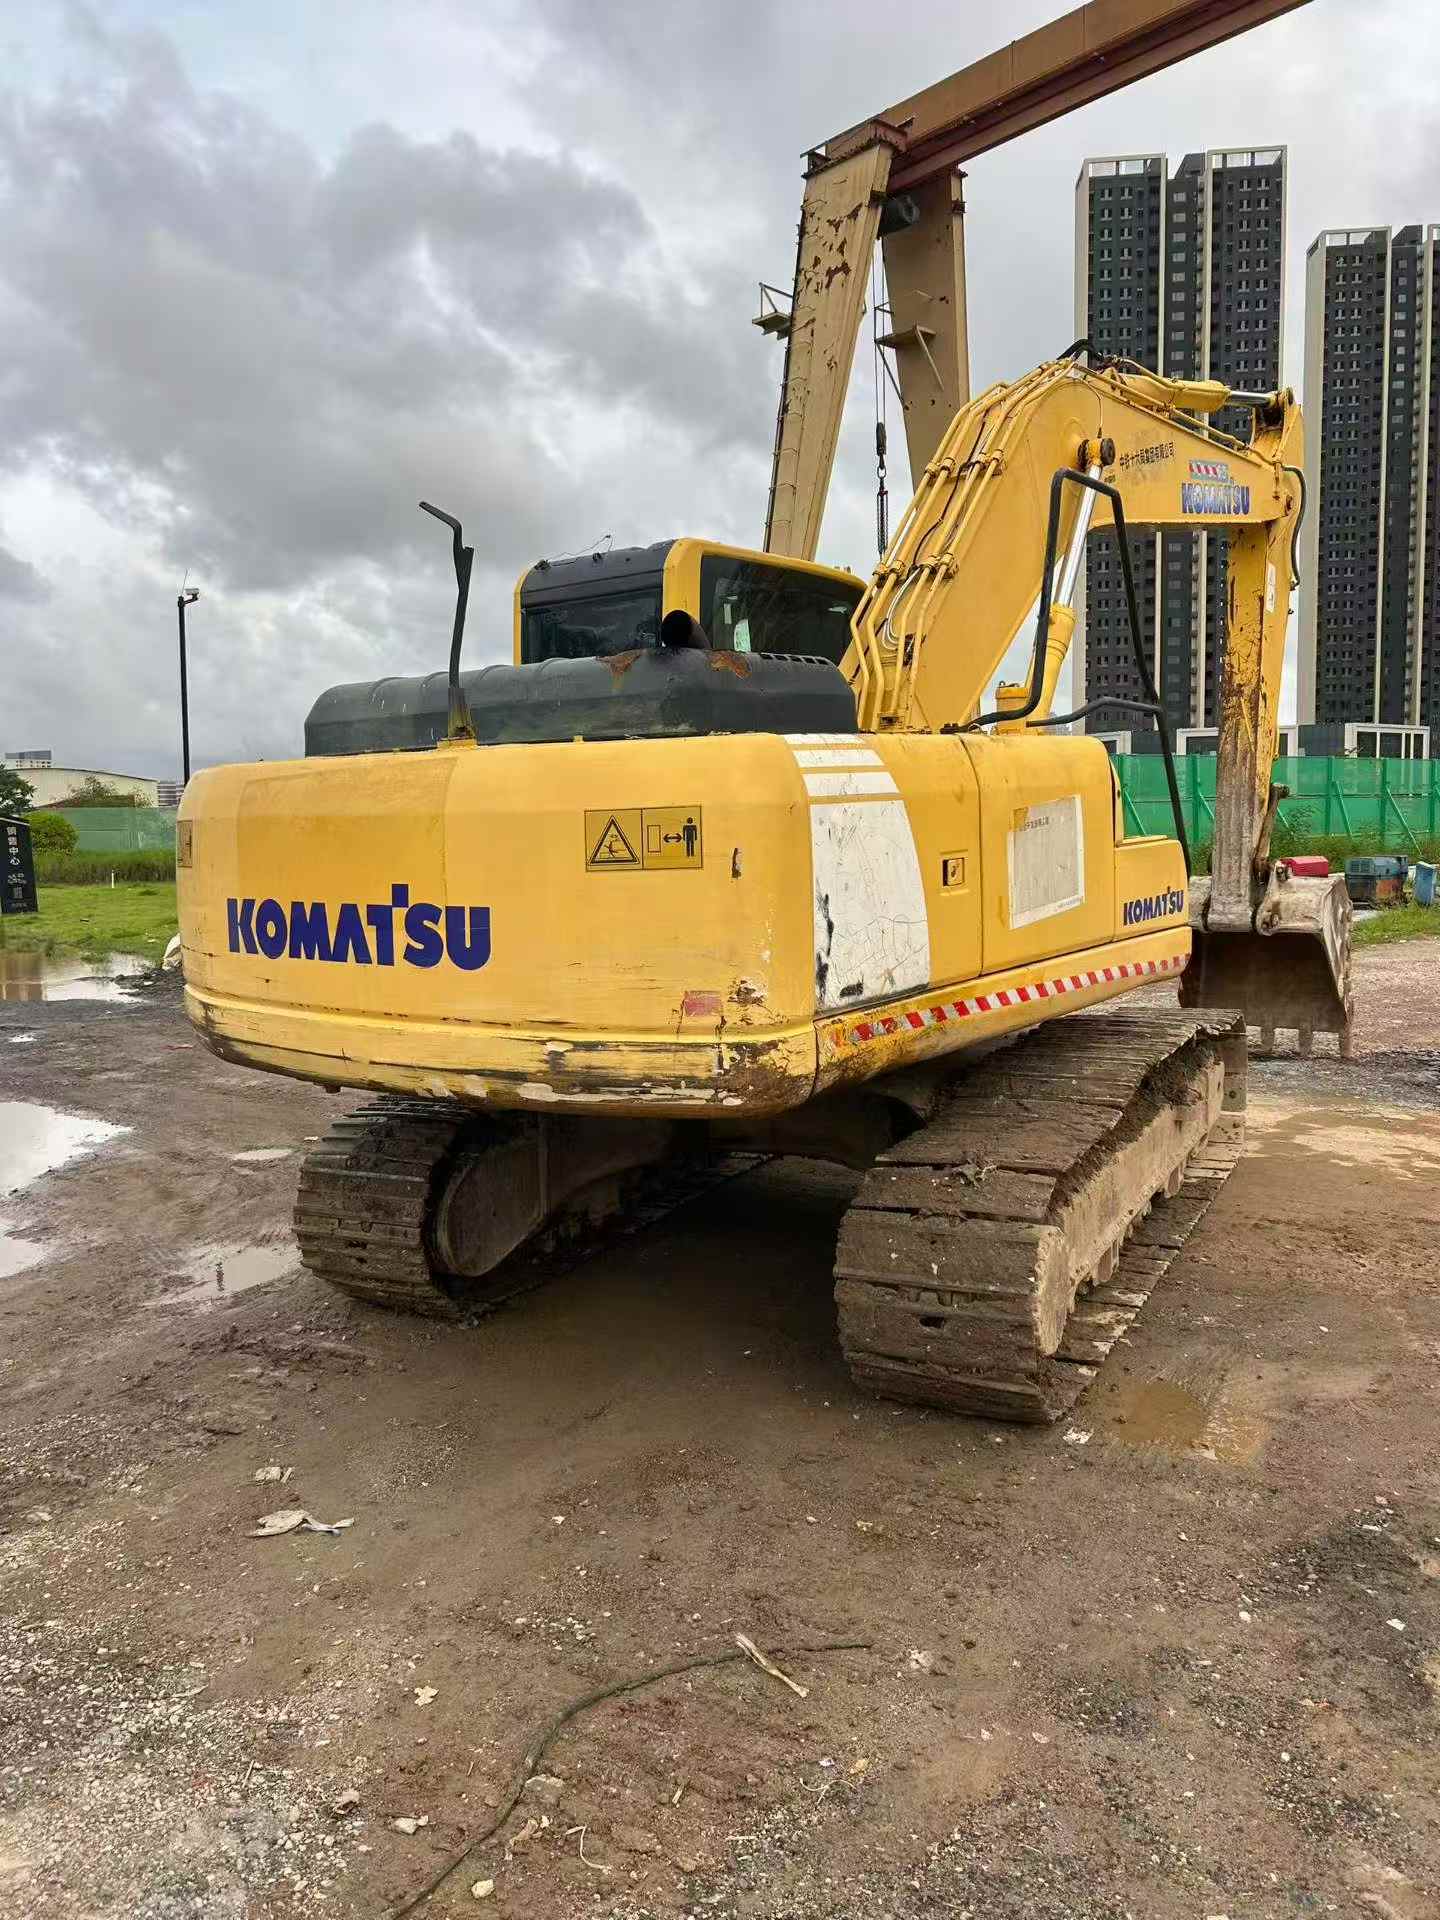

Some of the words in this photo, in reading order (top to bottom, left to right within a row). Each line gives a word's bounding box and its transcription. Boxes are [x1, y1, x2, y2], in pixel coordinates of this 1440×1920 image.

[1181, 478, 1250, 515] KOMATSU
[1123, 885, 1184, 926] KOMATSU
[226, 883, 491, 970] KOMATSU
